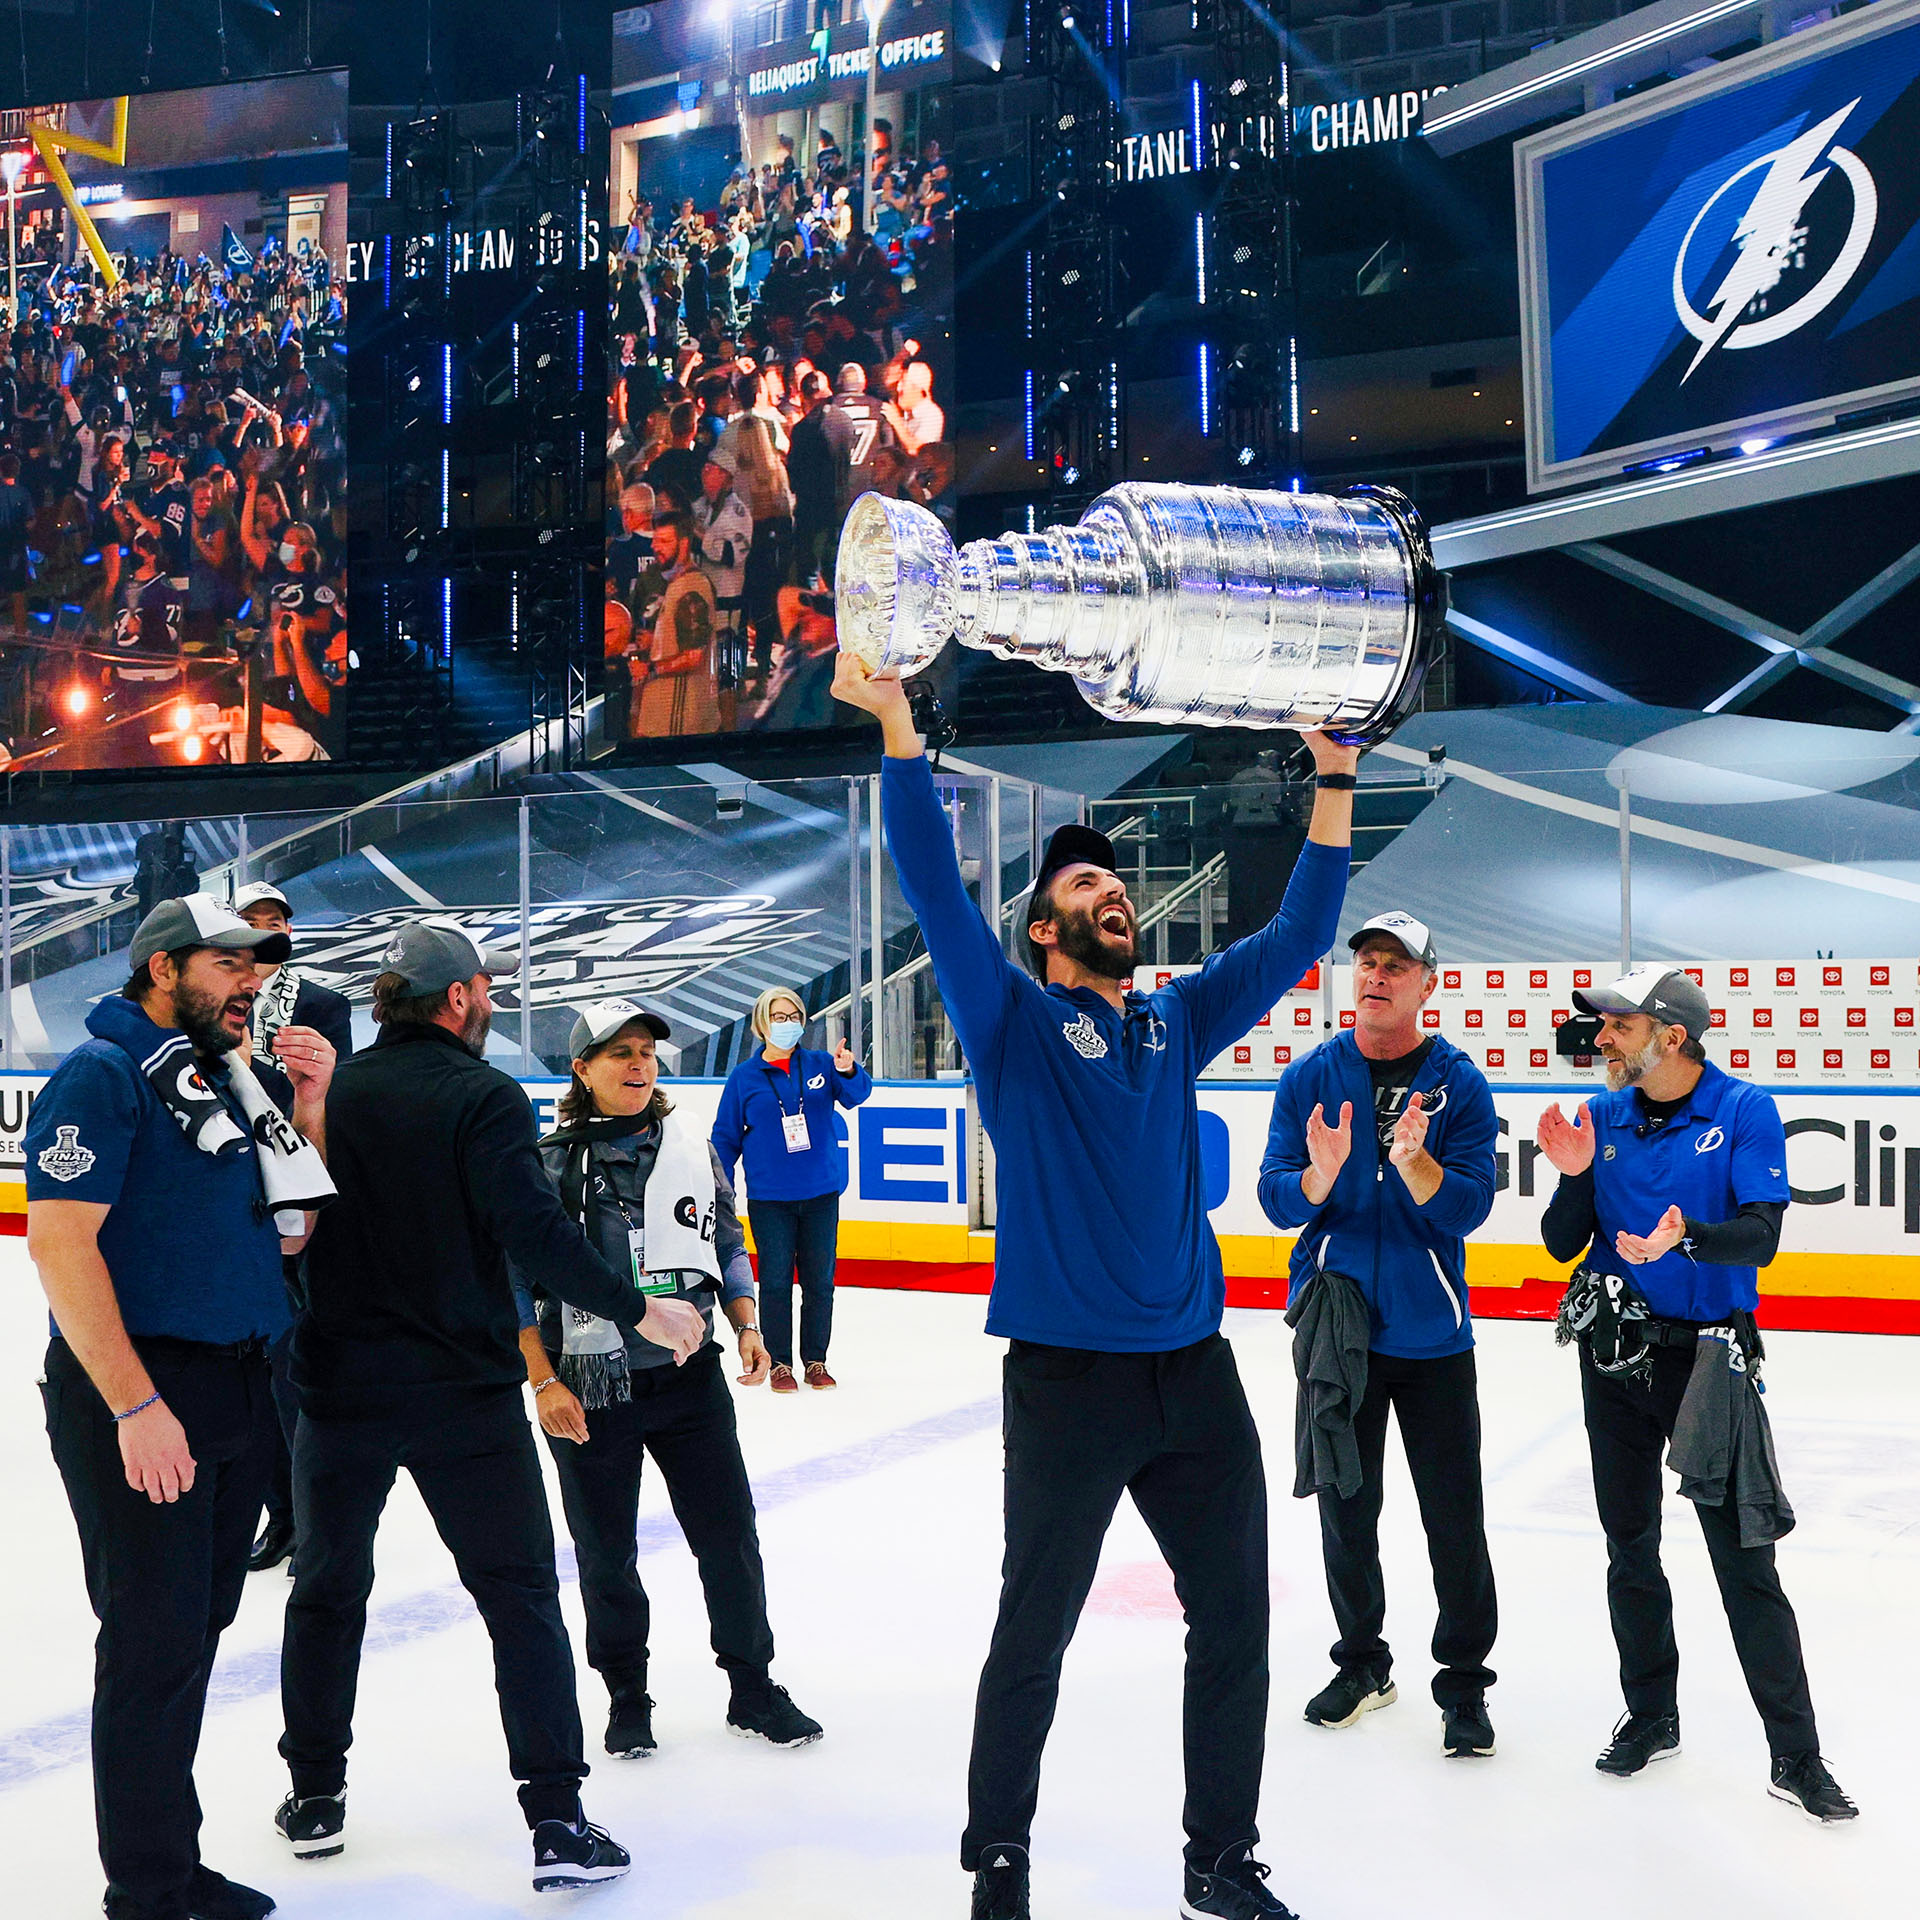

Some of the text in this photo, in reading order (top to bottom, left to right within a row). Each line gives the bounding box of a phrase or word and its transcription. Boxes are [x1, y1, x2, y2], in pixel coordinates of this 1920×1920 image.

[750, 30, 945, 96] RELIAQUEST TICKE OFFICE
[166, 502, 185, 523] 86
[605, 902, 752, 922] CUP
[1066, 1026, 1106, 1049] FINAL
[44, 1152, 91, 1162] FINAL
